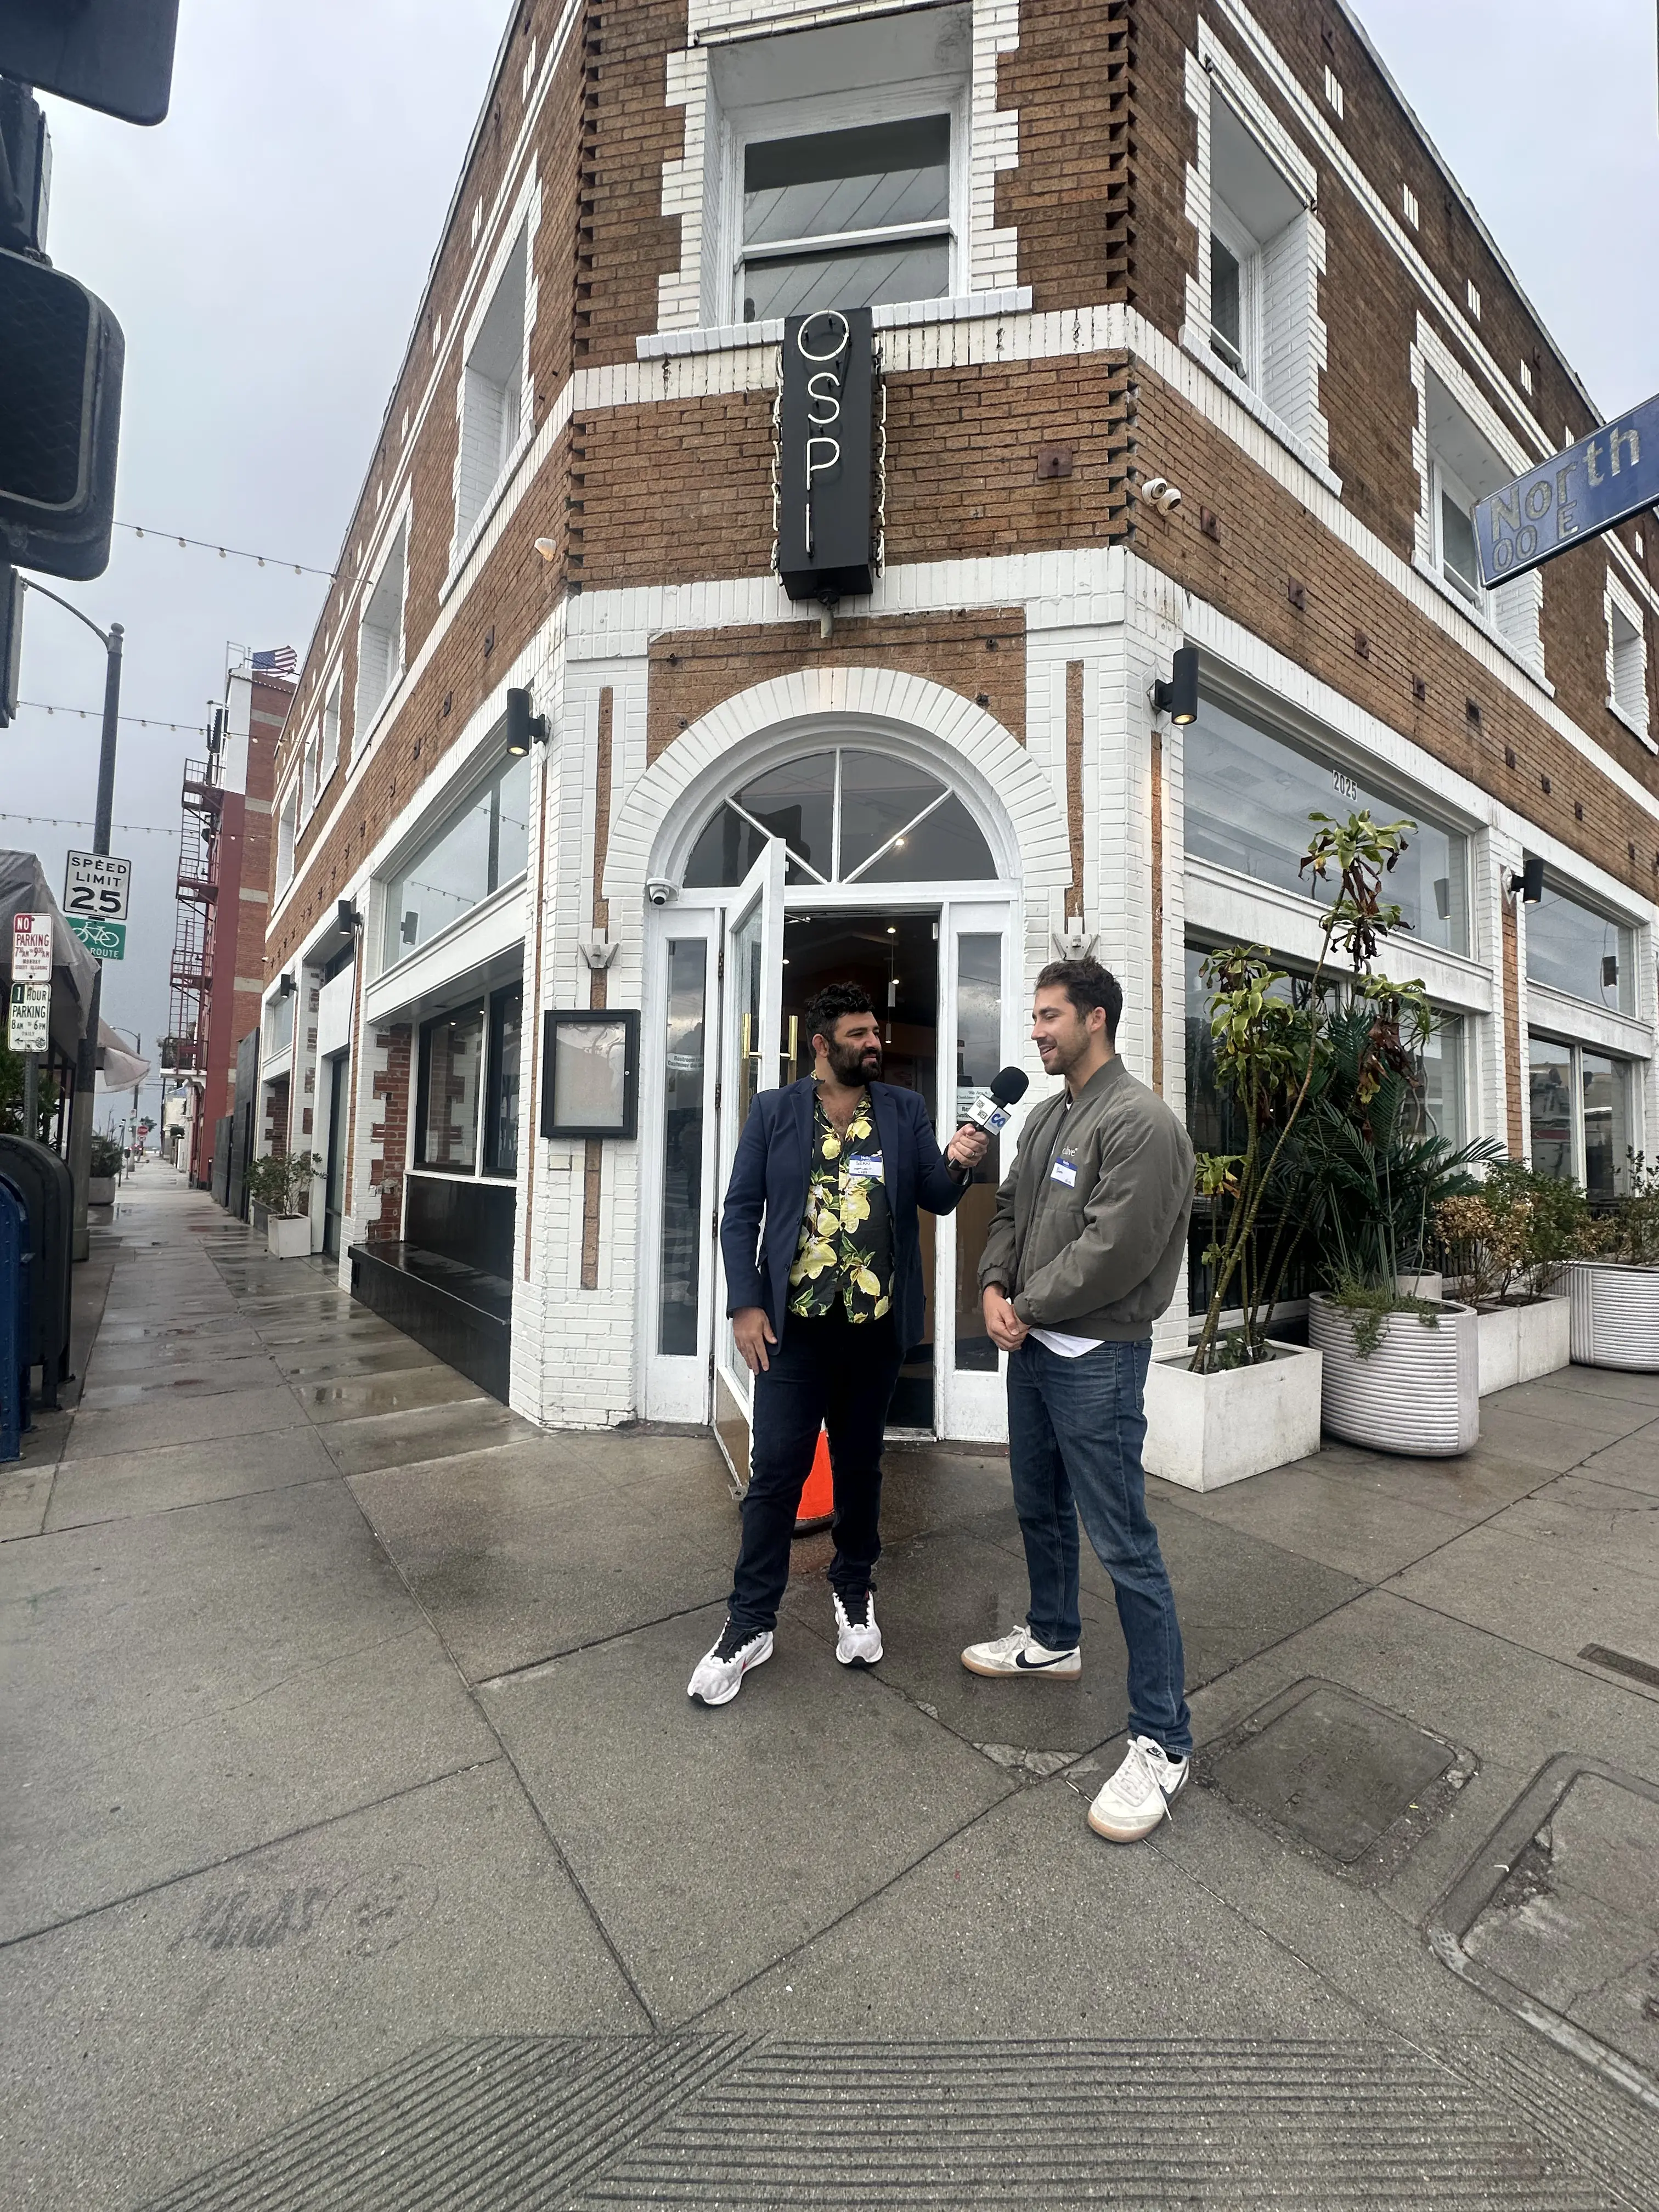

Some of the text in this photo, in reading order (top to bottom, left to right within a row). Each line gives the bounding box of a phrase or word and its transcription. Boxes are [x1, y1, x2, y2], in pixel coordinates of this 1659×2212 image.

[797, 309, 850, 553] OSPI
[1489, 427, 1640, 544] North
[1334, 771, 1357, 800] 2025
[71, 857, 127, 874] SPEED
[76, 871, 121, 887] LIMIT
[70, 887, 122, 913] 25
[16, 917, 30, 930] NO
[16, 934, 49, 947] PARKING
[90, 947, 119, 958] ROUTE
[17, 986, 47, 1001] 1 HOUR
[12, 1005, 46, 1018] PARKING
